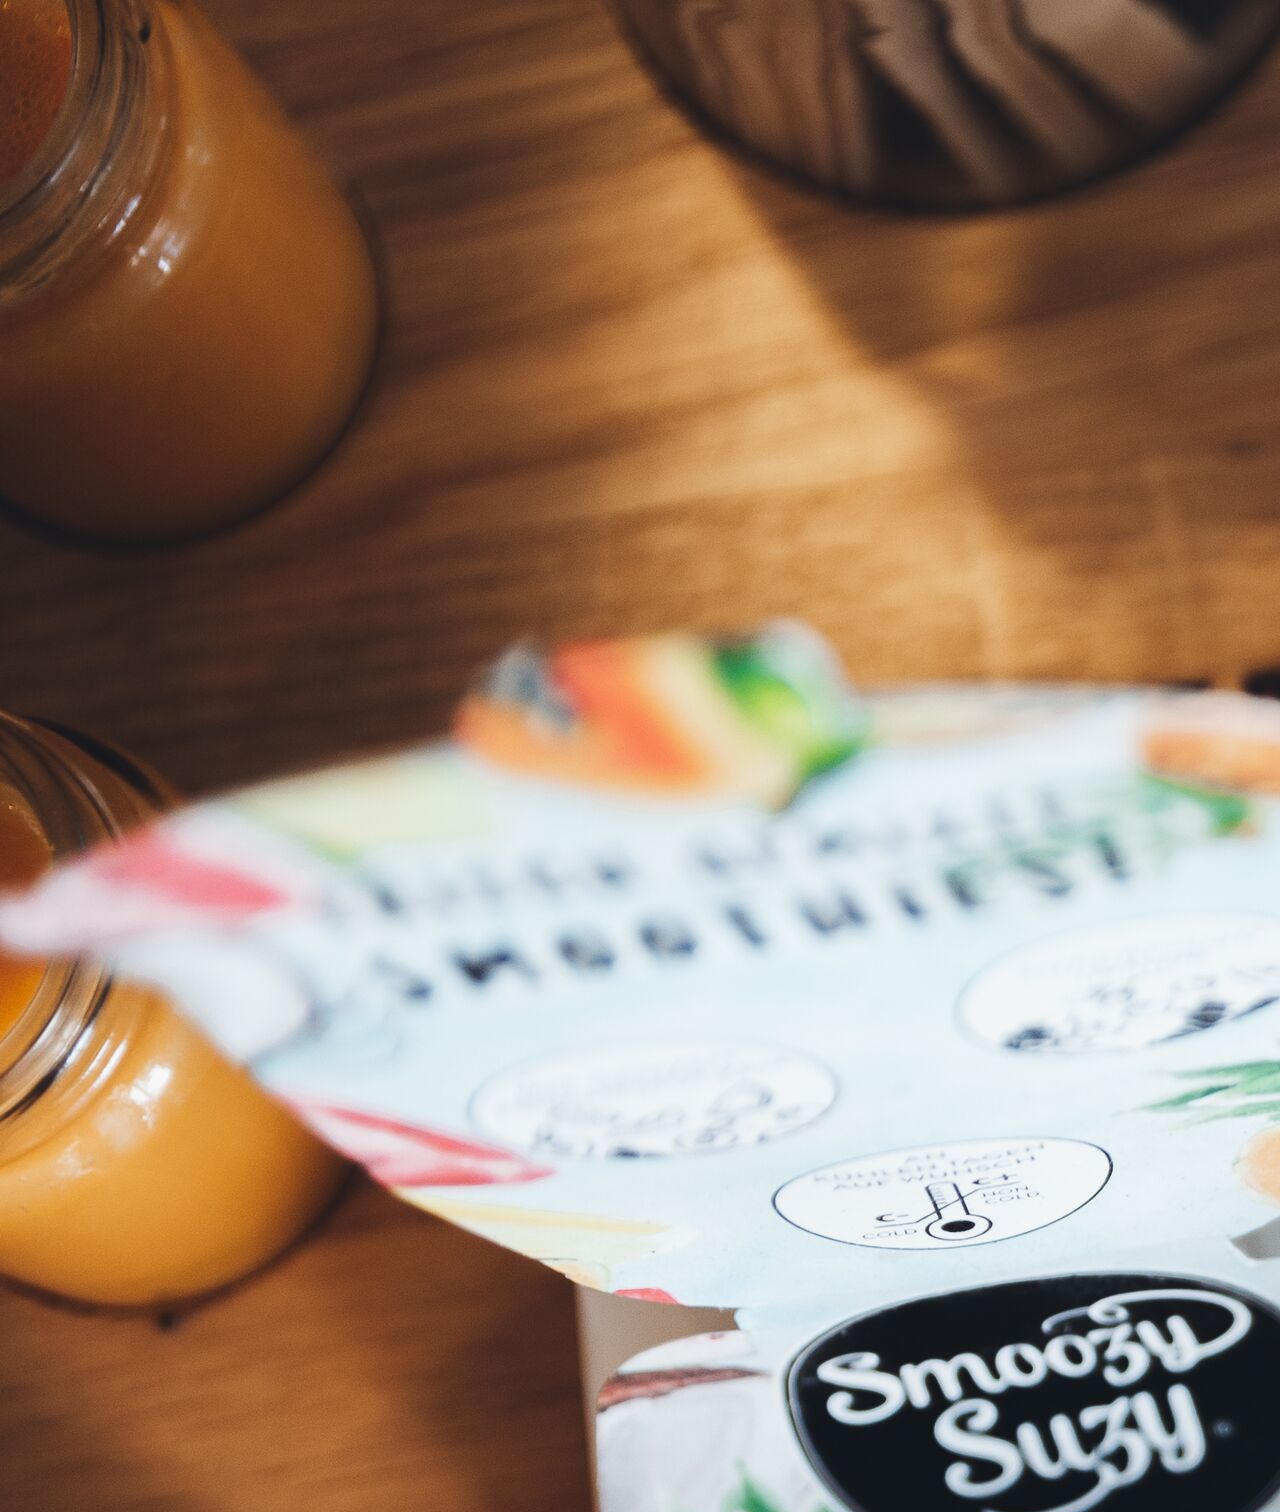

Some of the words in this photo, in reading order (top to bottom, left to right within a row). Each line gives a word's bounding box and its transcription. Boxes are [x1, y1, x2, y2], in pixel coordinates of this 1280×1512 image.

[984, 1191, 1042, 1206] COLD
[861, 1228, 918, 1241] COLD
[816, 1288, 1253, 1427] Smoozy
